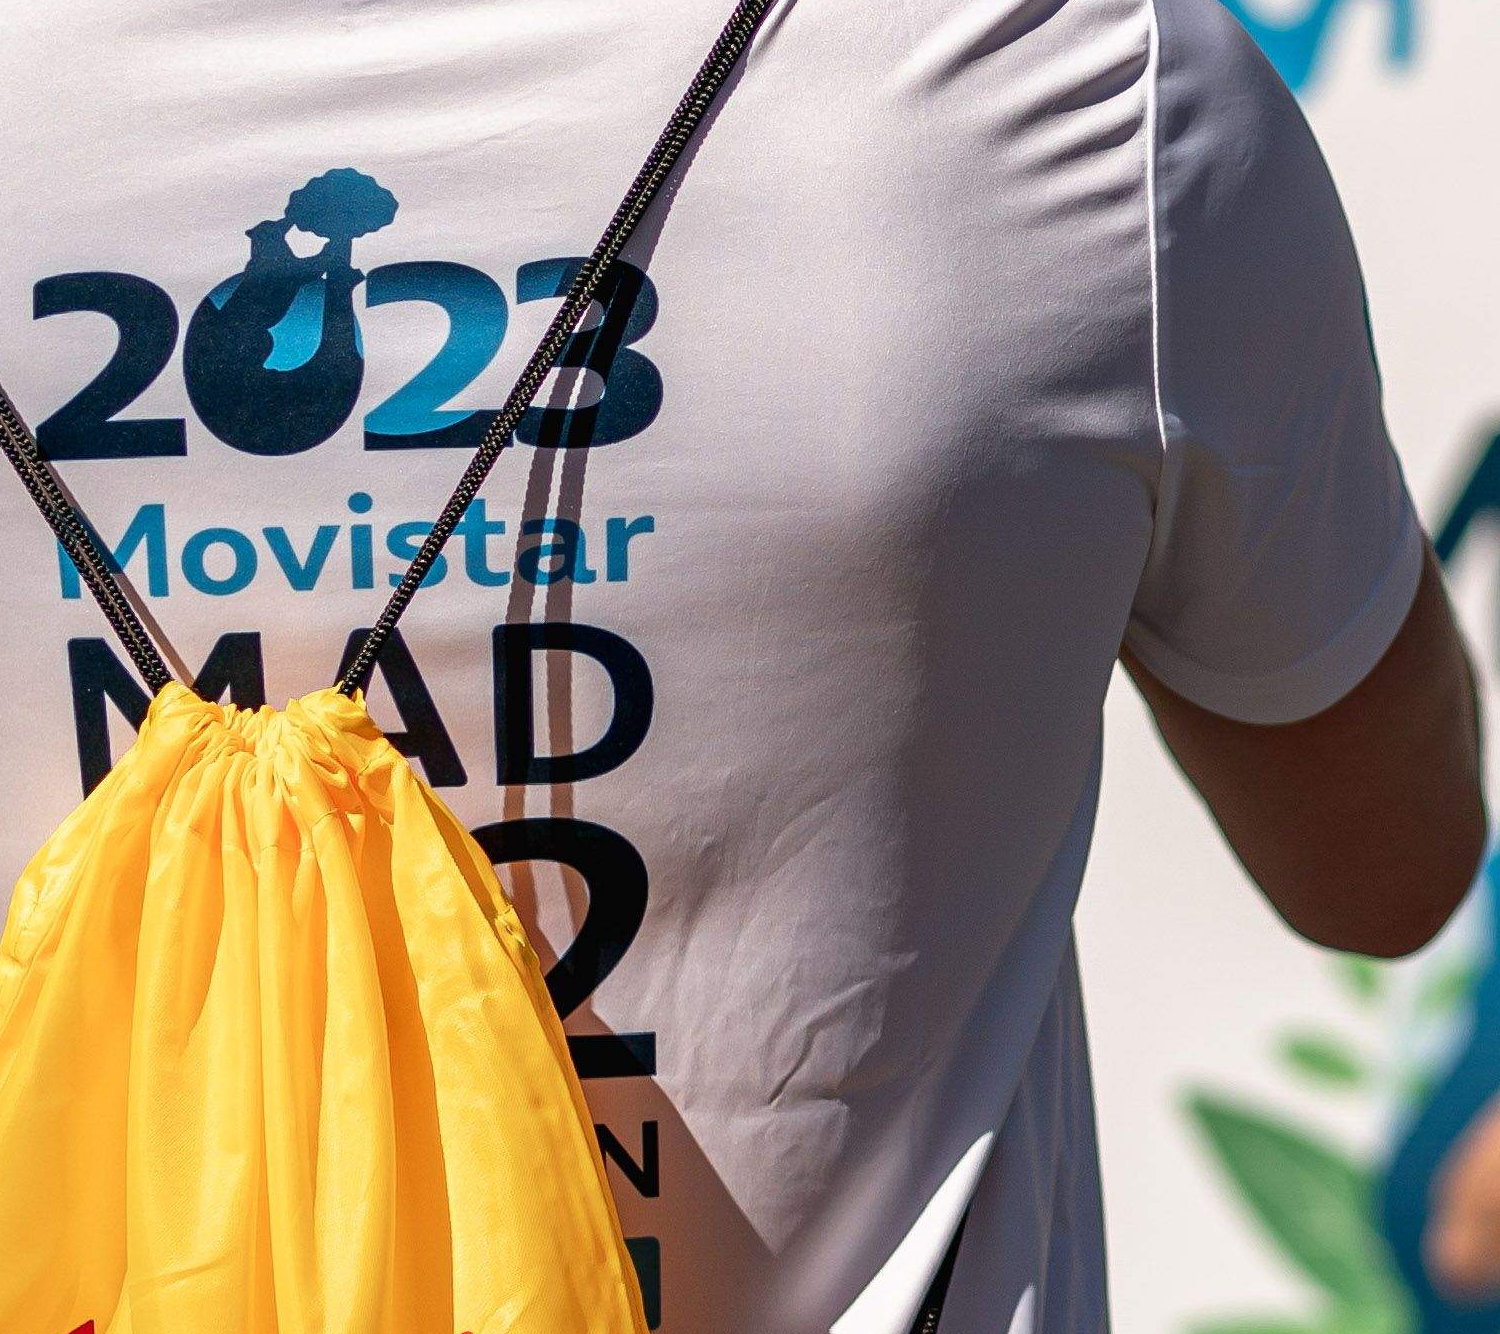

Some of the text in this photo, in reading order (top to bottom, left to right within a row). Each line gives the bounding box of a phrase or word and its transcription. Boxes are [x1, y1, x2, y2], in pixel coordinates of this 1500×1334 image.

[33, 257, 663, 460] 2023
[56, 493, 655, 600] Movistar
[67, 622, 655, 800] MAD
